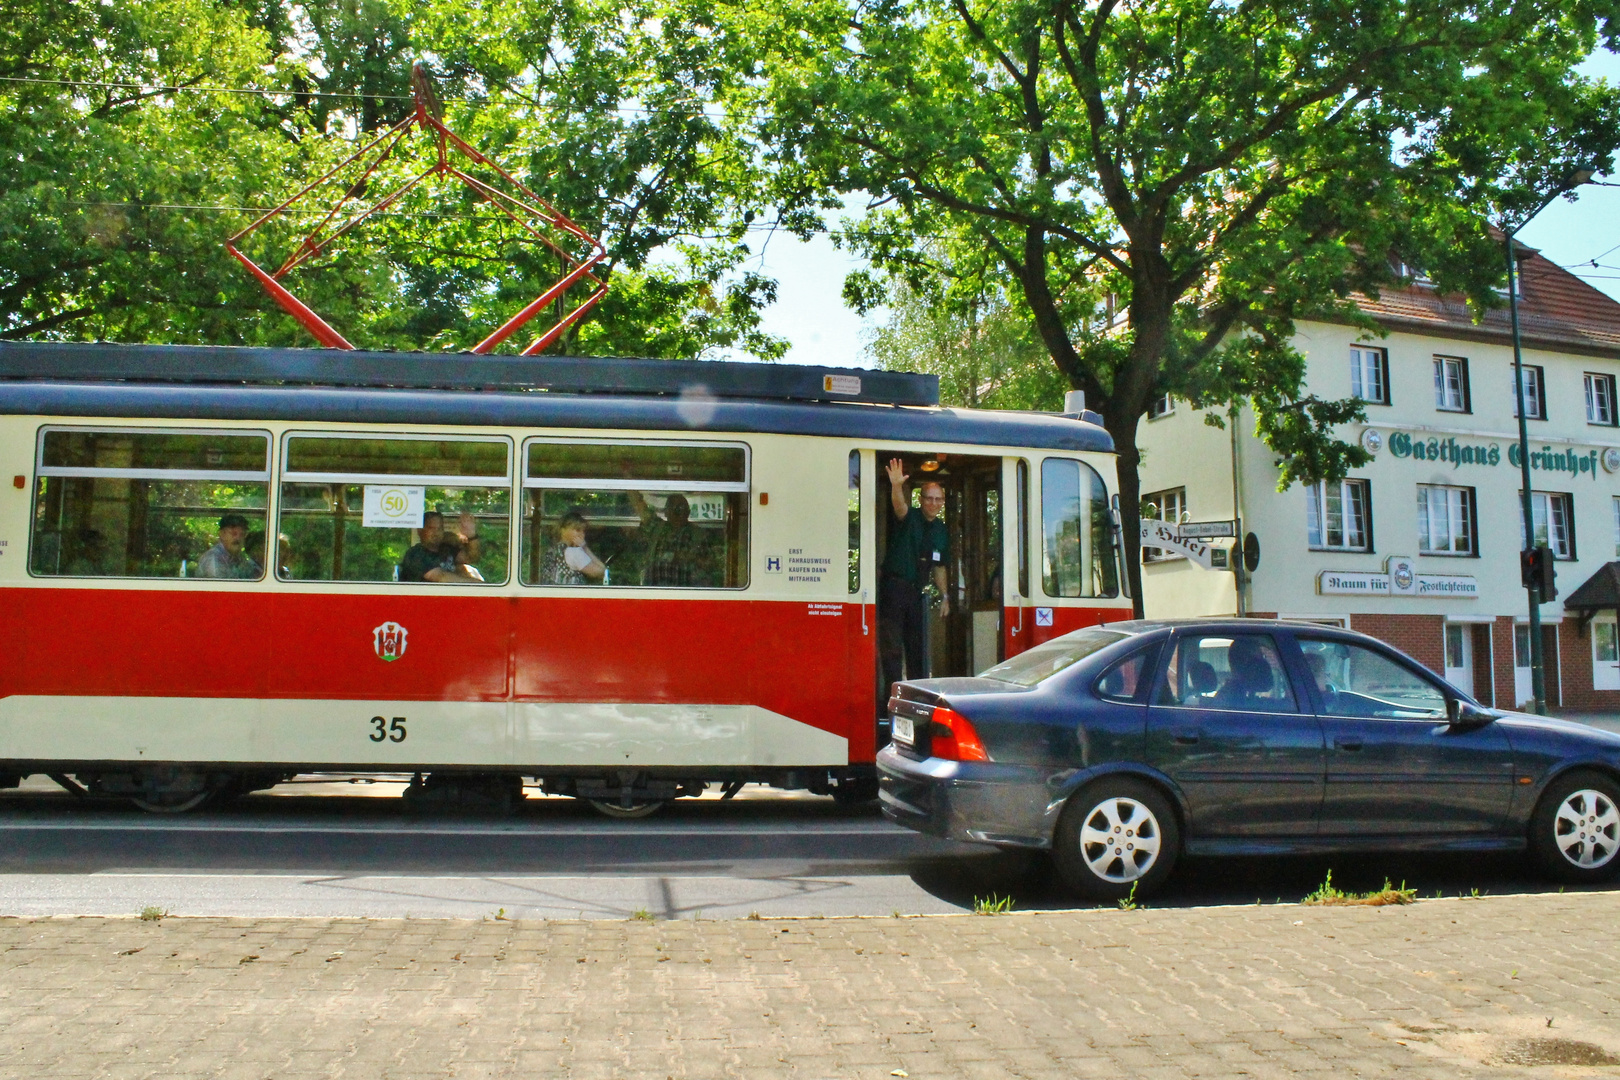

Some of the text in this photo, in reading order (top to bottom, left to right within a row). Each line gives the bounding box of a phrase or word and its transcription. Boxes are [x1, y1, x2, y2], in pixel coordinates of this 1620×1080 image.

[833, 376, 859, 384] Achtung
[1388, 431, 1597, 481] Gasthaus Grünhof
[385, 496, 404, 511] 50
[1155, 526, 1206, 557] Hotel
[1328, 577, 1476, 593] Raum für Festlichkeiten
[369, 716, 407, 743] 35
